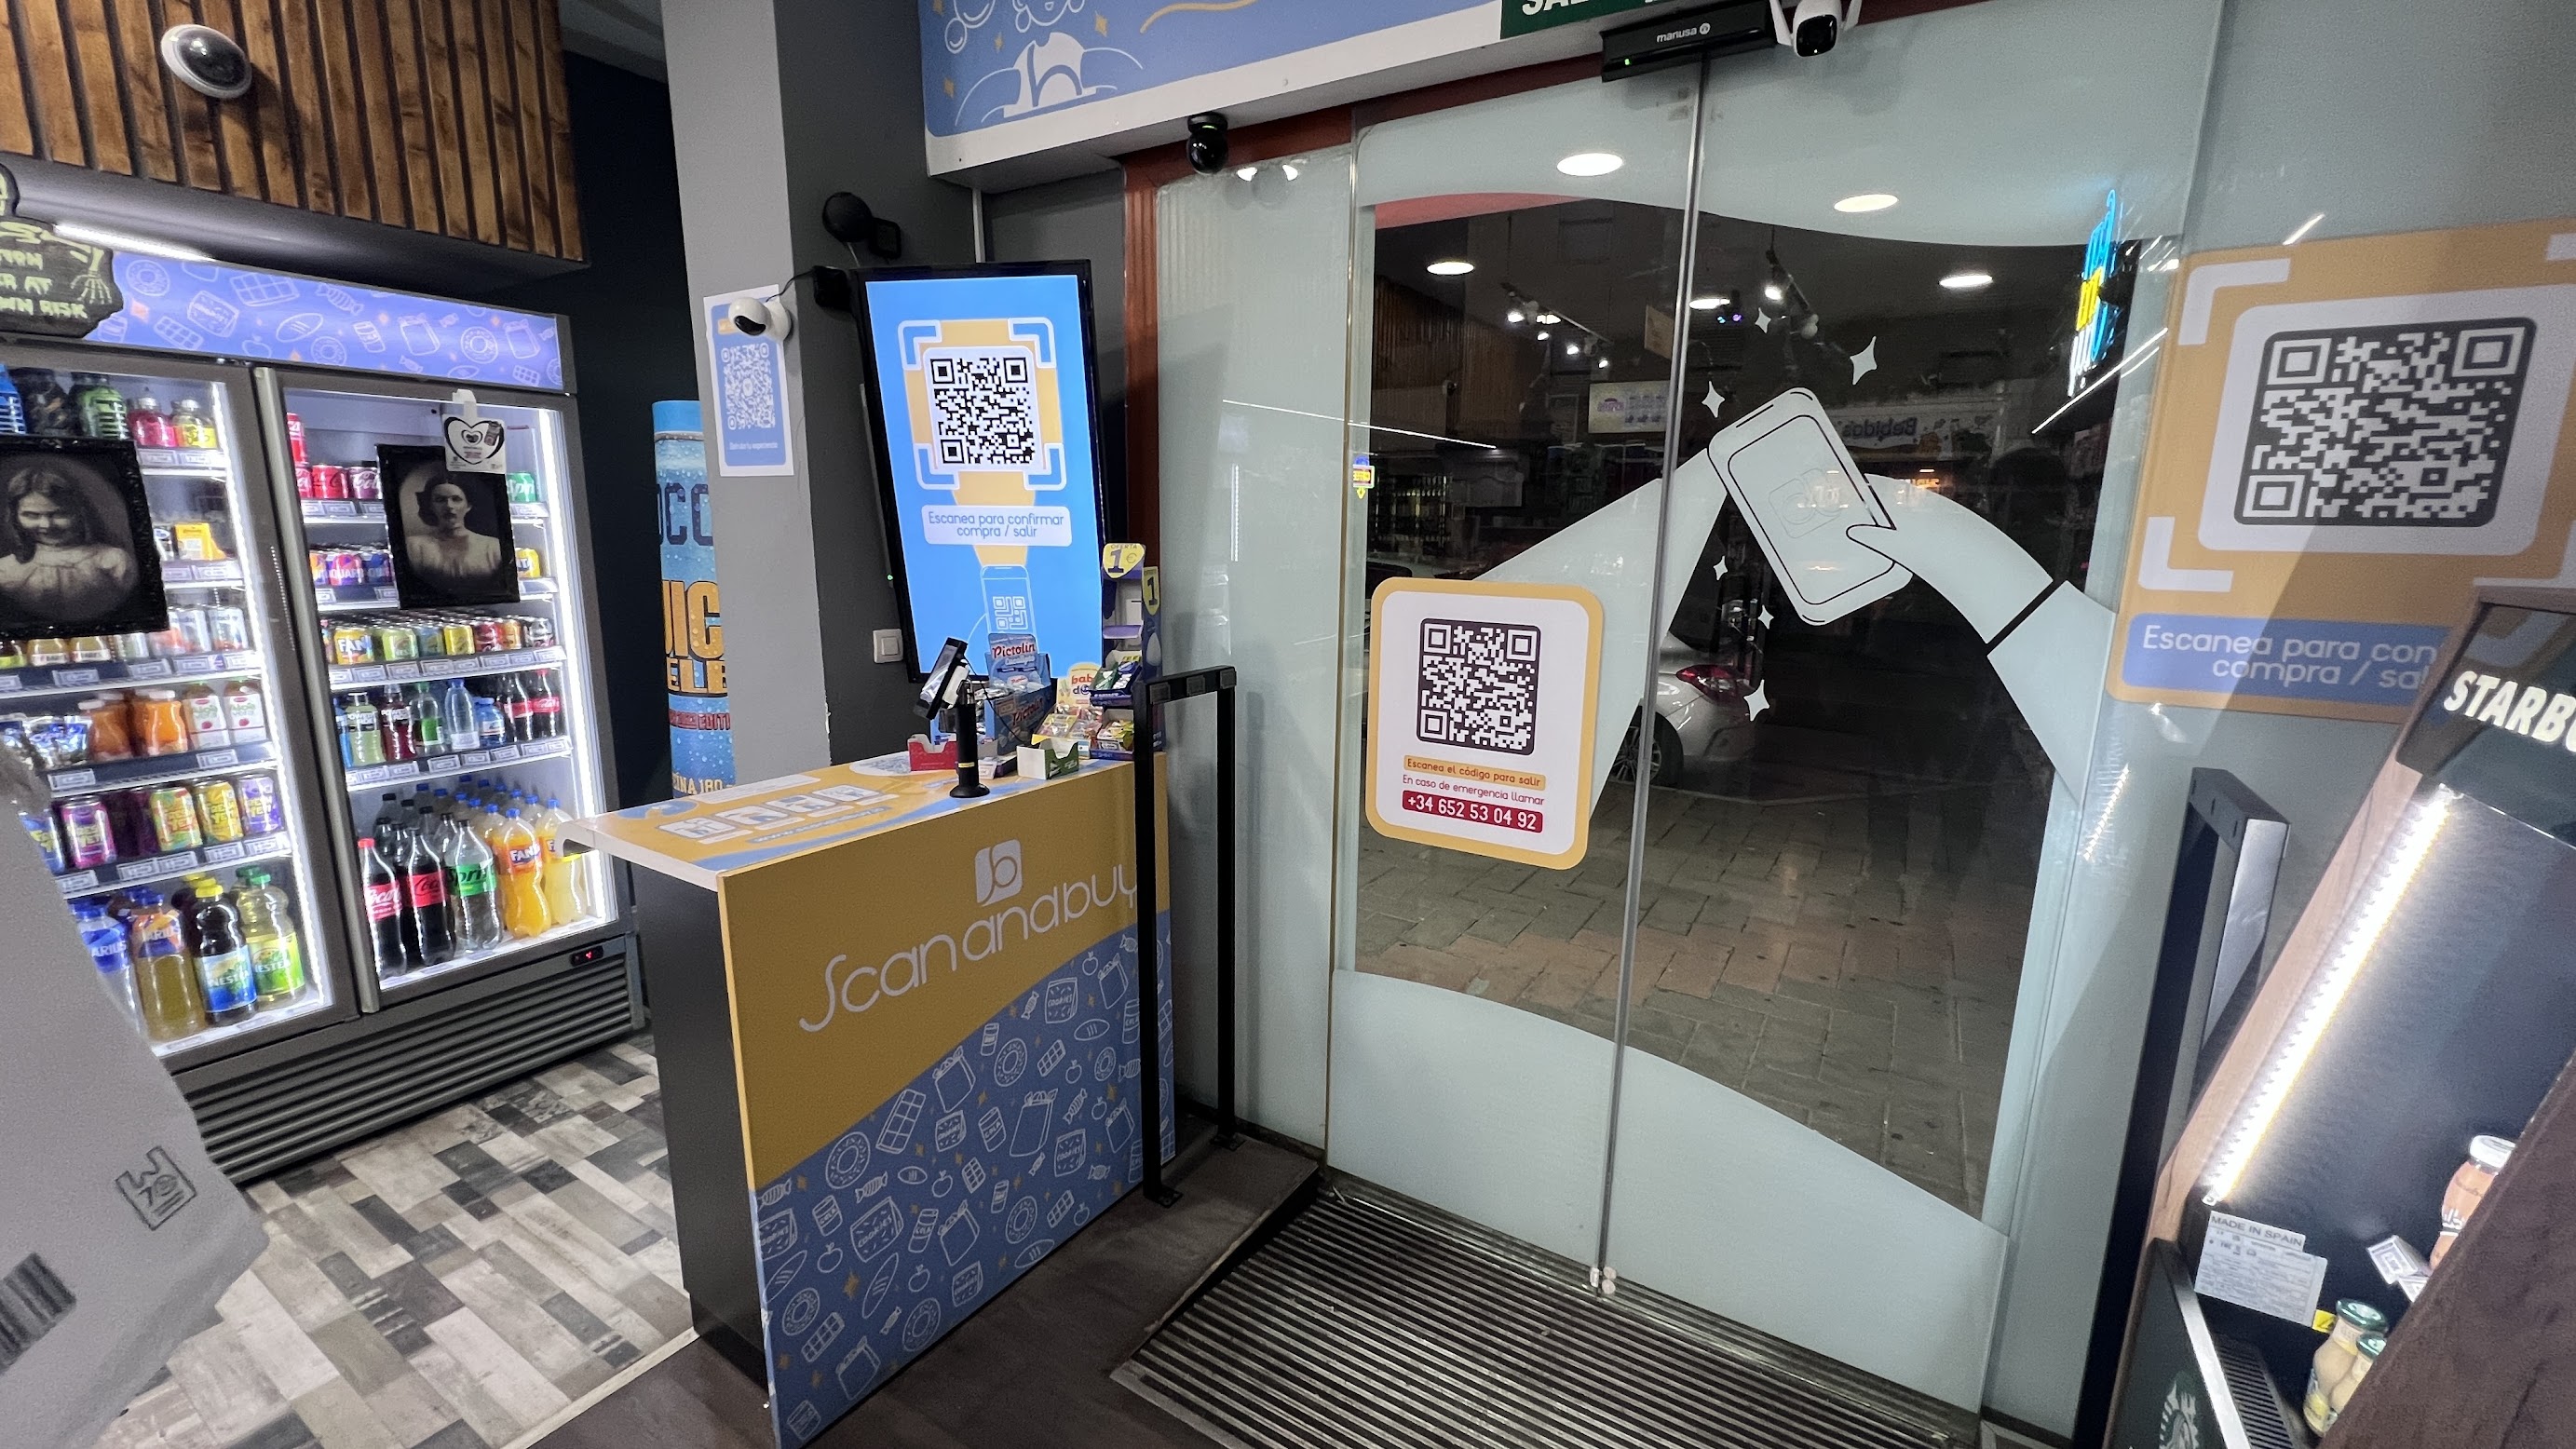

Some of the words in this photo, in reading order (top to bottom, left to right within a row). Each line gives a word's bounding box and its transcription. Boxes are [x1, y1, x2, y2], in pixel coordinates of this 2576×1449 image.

[1656, 27, 1698, 43] manusa
[39, 300, 88, 318] RISK
[928, 511, 975, 524] Escanea
[978, 514, 1004, 527] para
[1007, 512, 1064, 526] confirmar
[956, 525, 1001, 539] compra
[1004, 525, 1010, 537] /
[1013, 524, 1037, 538] salir
[1107, 548, 1124, 574] 1
[1126, 552, 1137, 564] €
[1147, 576, 1159, 606] 1
[992, 643, 1036, 659] Pictolin
[2142, 625, 2273, 656] Escanea
[2281, 638, 2361, 662] para
[2212, 658, 2341, 687] compra
[2349, 660, 2372, 686] /
[1407, 758, 1444, 773] Escanea
[1447, 765, 1456, 775] el
[1458, 766, 1490, 780] código
[1493, 773, 1515, 783] para
[1519, 776, 1541, 787] salir
[1403, 774, 1414, 784] En
[1416, 779, 1437, 789] caso
[1439, 780, 1450, 791] de
[1453, 785, 1509, 801] emergencia
[1511, 792, 1545, 806] llamar
[1407, 794, 1434, 812] +34
[1438, 798, 1465, 818] 652
[1469, 804, 1489, 821] 53
[1493, 807, 1512, 826] 04
[1517, 811, 1537, 830] 92
[984, 1121, 1001, 1139] COLA
[858, 1215, 893, 1248] COOKIES
[2211, 1215, 2246, 1231] MADE
[2248, 1226, 2261, 1236] IN
[2264, 1229, 2303, 1248] SPAIN
